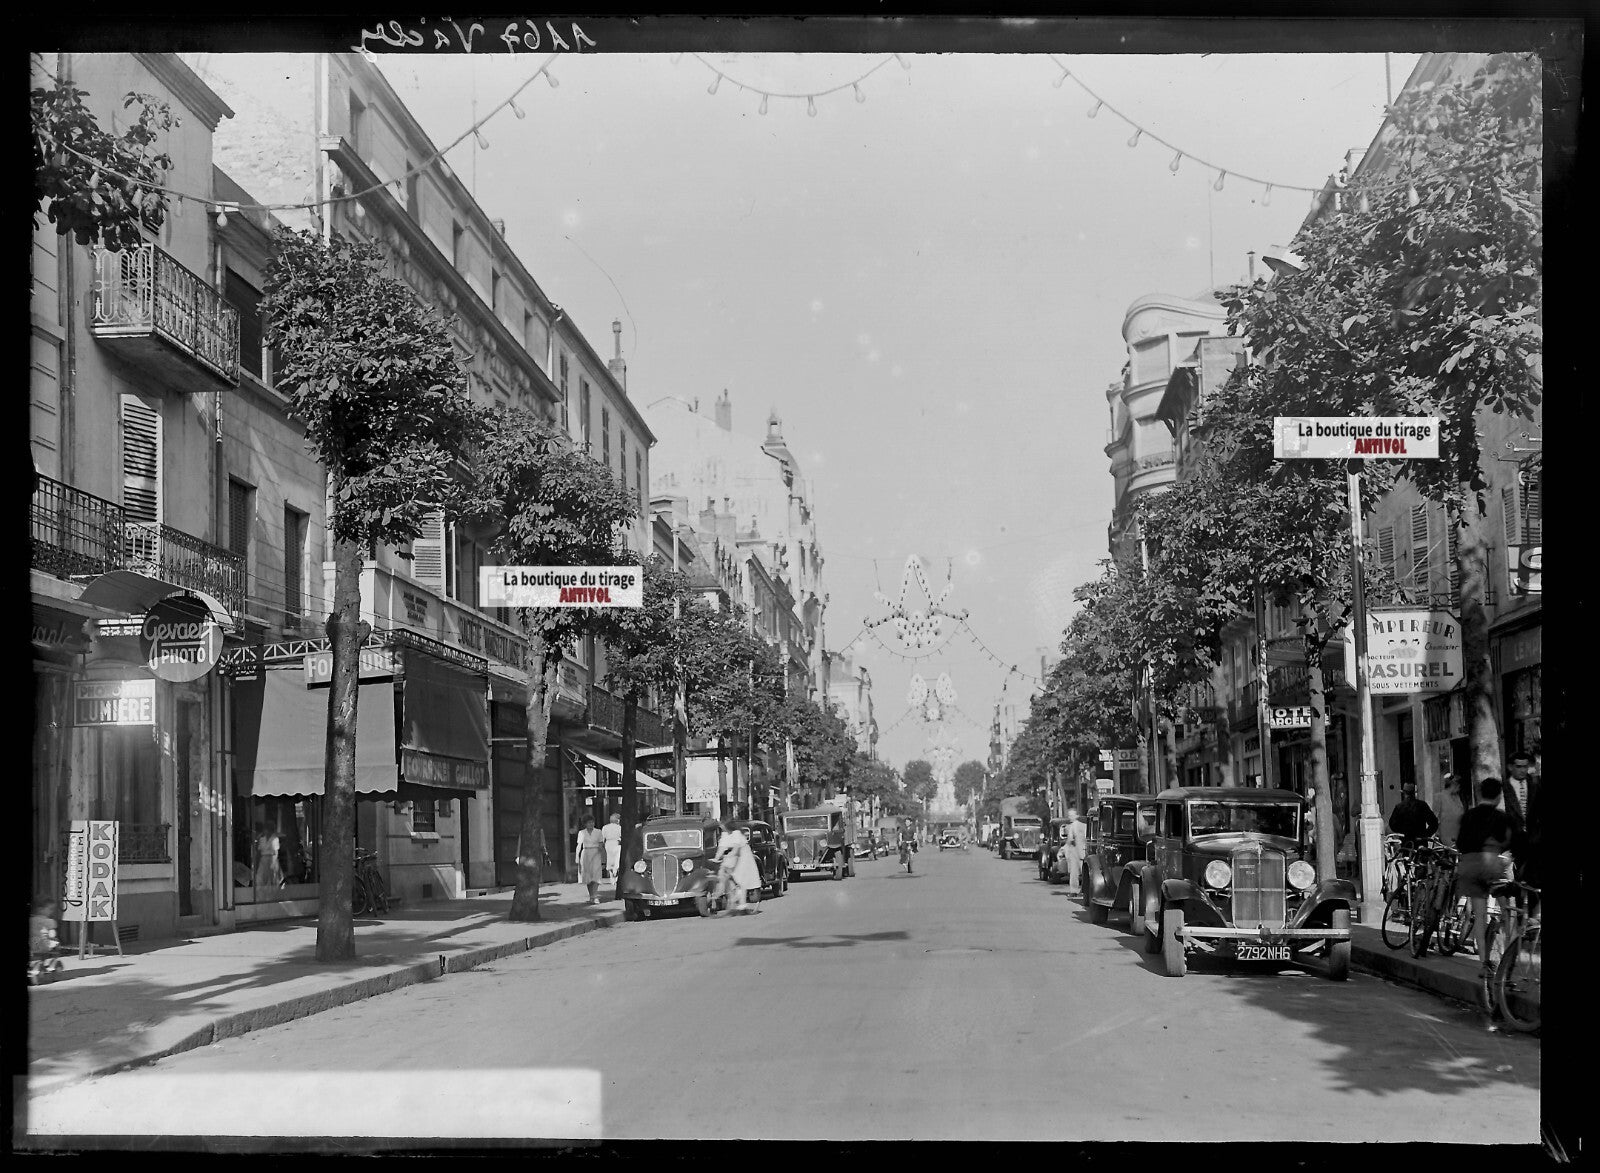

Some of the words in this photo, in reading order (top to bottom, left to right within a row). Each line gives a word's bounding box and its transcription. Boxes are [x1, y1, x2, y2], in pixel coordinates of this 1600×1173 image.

[143, 615, 219, 670] Gevaert
[161, 646, 206, 664] PHOTO
[1368, 662, 1454, 678] ASUREL
[91, 823, 111, 918] KODAK
